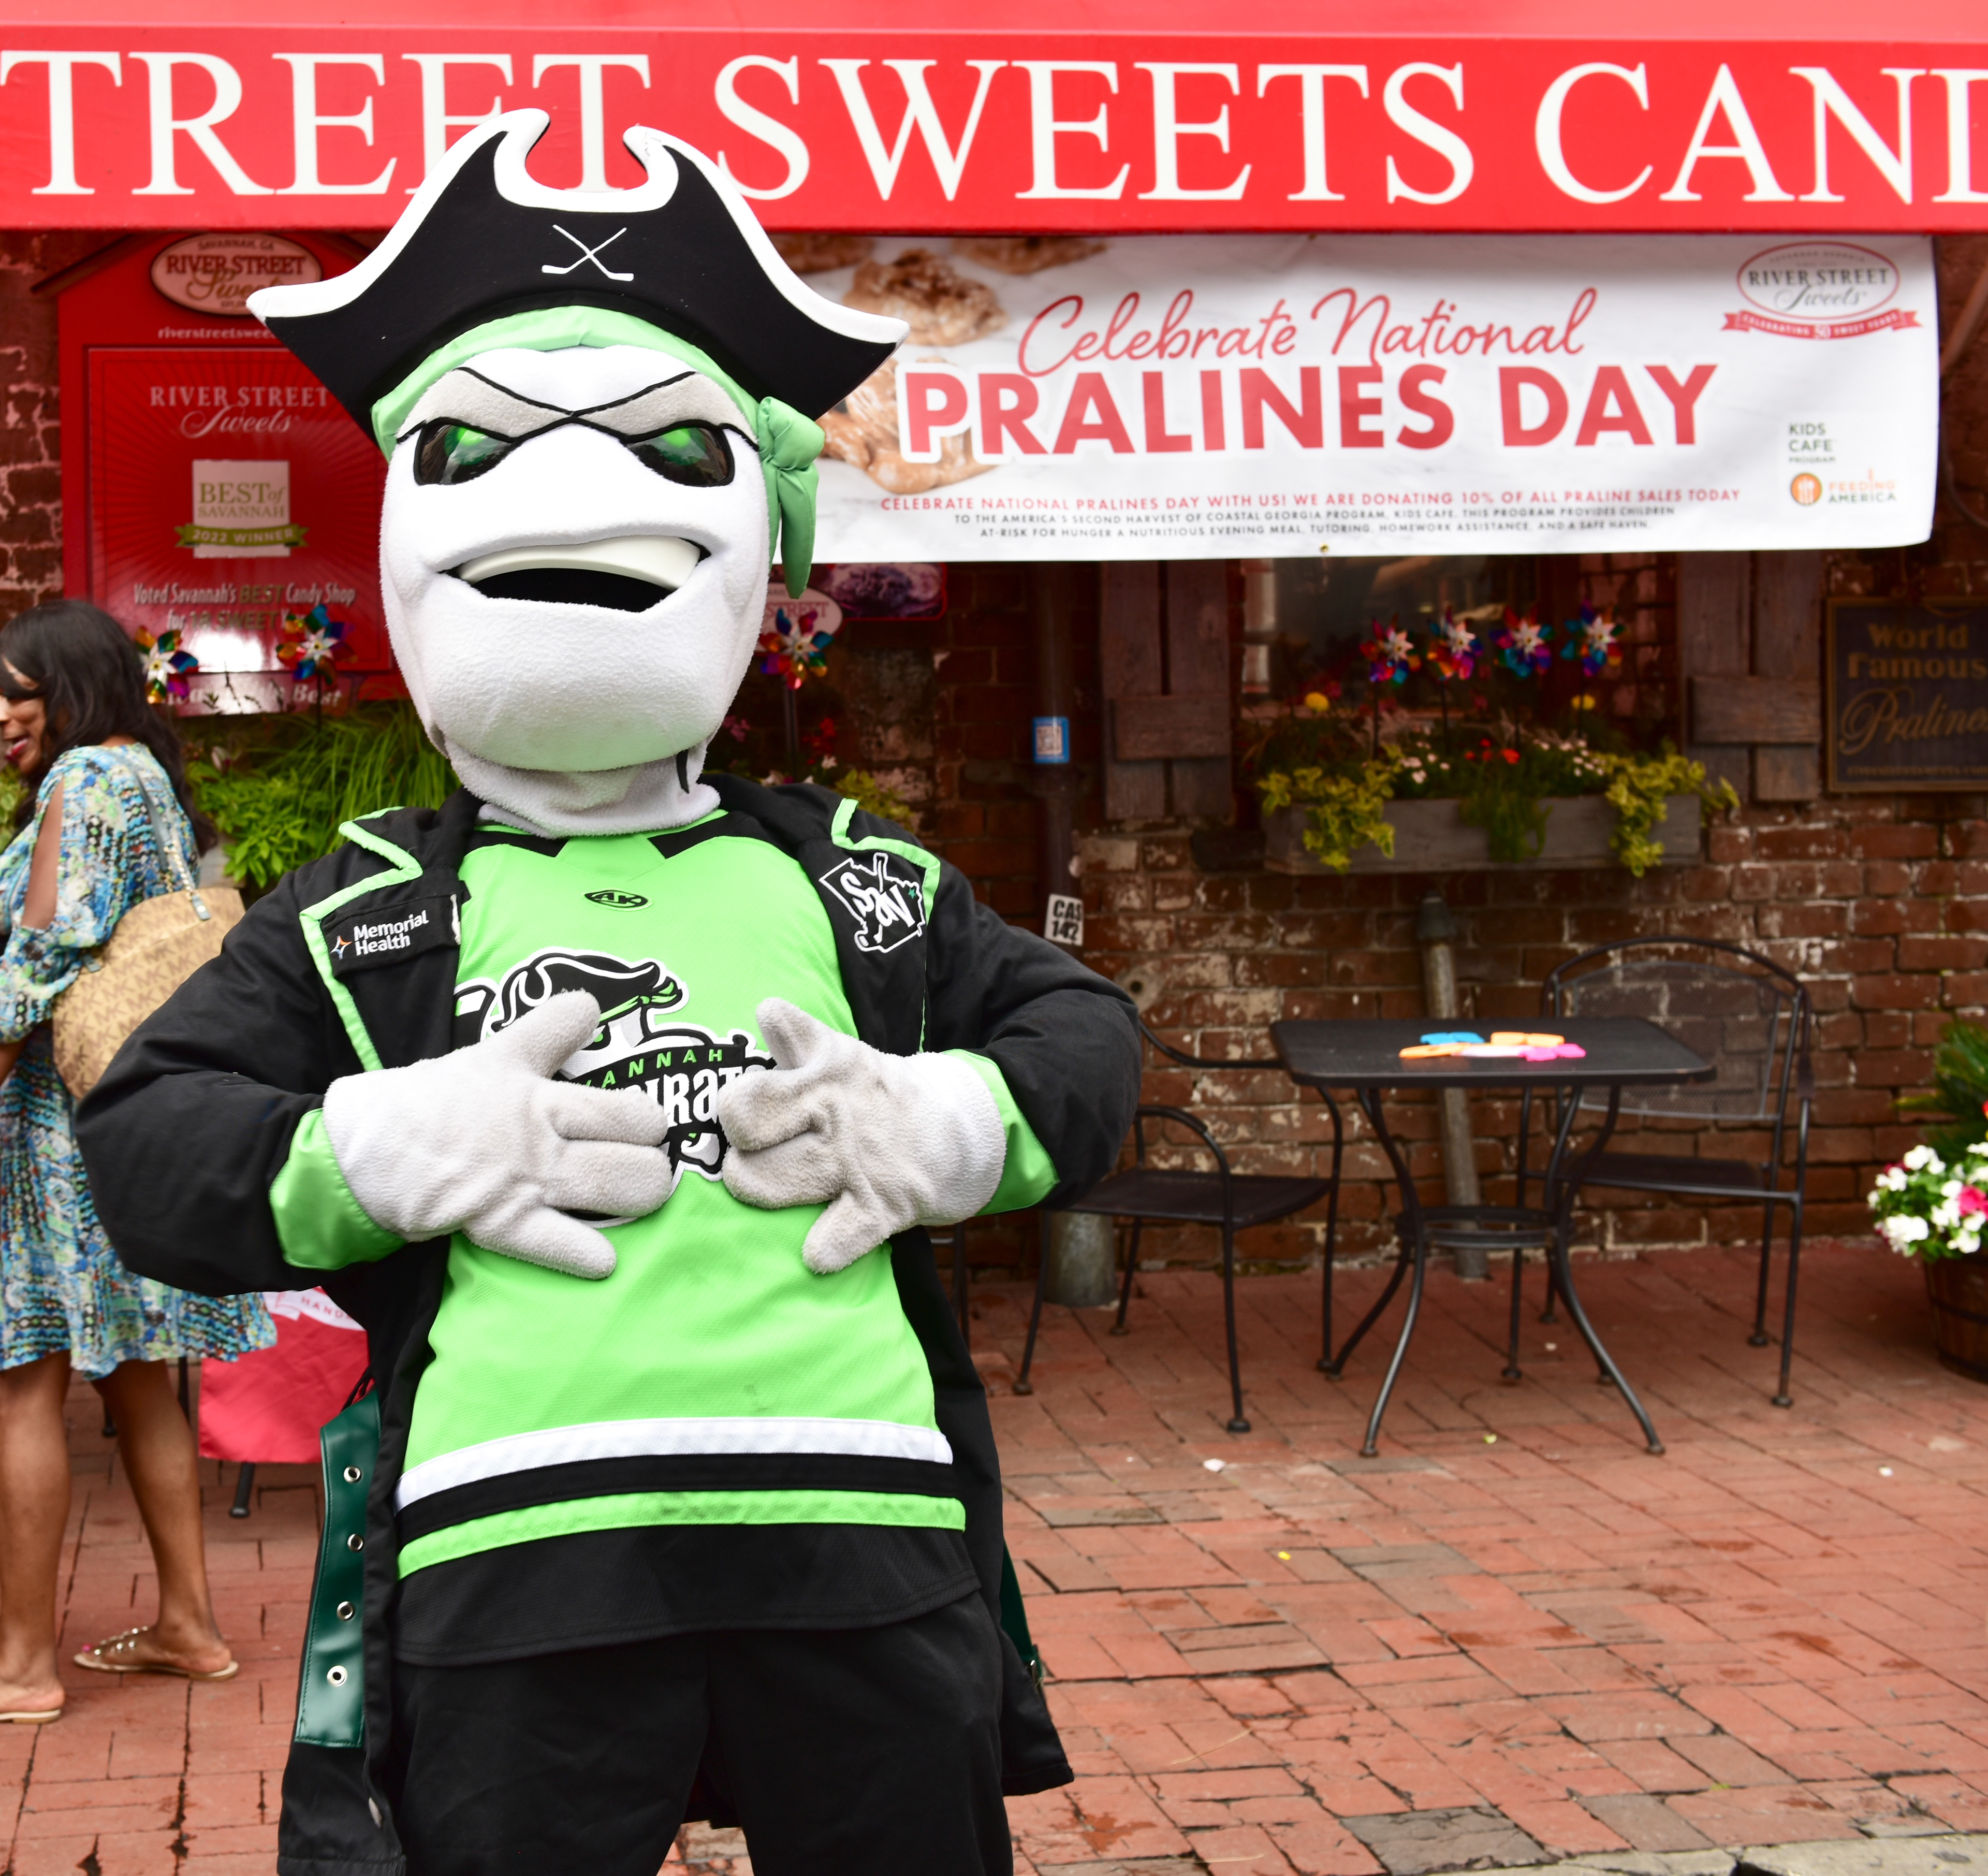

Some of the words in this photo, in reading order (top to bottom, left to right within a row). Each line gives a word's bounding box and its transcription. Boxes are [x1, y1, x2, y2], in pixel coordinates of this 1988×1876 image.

[714, 54, 1474, 204] SWEETS
[167, 255, 227, 274] RIVER
[233, 256, 306, 274] STREET
[1748, 269, 1809, 286] RIVER
[1816, 268, 1889, 284] STREET
[1774, 285, 1861, 311] Sweets
[1018, 288, 1297, 377] Celebrate
[1310, 287, 1598, 369] National
[150, 386, 228, 406] RIVER
[237, 386, 328, 406] STREET
[905, 363, 1455, 455] PRALINES
[1498, 364, 1718, 447] DAY
[181, 404, 293, 439] Sweets
[1790, 423, 1826, 435] KIDS
[1789, 440, 1833, 452] CAFE
[200, 483, 270, 503] BEST
[268, 486, 286, 504] of
[881, 498, 973, 510] CELEBRATE
[982, 498, 1070, 510] NATIONAL
[1077, 498, 1158, 511] PRALINES
[1166, 497, 1200, 509] DAY
[1208, 496, 1252, 507] WITH
[1259, 495, 1287, 507] US!
[1294, 495, 1318, 506] WE
[1326, 493, 1355, 505] ARE
[1362, 493, 1453, 504] DONATING
[1462, 491, 1495, 504] 10%
[1501, 491, 1523, 504] OF
[1530, 491, 1557, 503] ALL
[1565, 490, 1631, 503] PRALINE
[1638, 489, 1683, 502] SALES
[1688, 489, 1740, 501] TODAY
[1829, 492, 1896, 503] AMERICA
[198, 506, 284, 517] SAVANNAH
[955, 515, 970, 523] TO
[976, 515, 997, 523] THE
[1002, 514, 1068, 523] AMERICA'S
[1073, 515, 1121, 523] SECOND
[1127, 514, 1180, 523] HARVEST
[1186, 513, 1202, 522] OF
[1207, 512, 1260, 521] COASTAL
[1265, 511, 1321, 520] GEORGIA
[1394, 510, 1421, 518] KIDS
[1463, 508, 1488, 517] THIS
[1493, 507, 1555, 517] PROGRAM
[1560, 506, 1616, 516] PROVIDES
[1620, 506, 1675, 515] CHILDREN
[193, 529, 228, 543] 2022
[233, 528, 294, 543] WINNER
[980, 529, 1028, 537] AT-RISK
[1033, 529, 1056, 537] FOR
[1062, 529, 1112, 537] HUNGER
[1130, 527, 1205, 536] NUTRITIOUS
[1210, 526, 1265, 535] EVENING
[1380, 523, 1451, 532] HOMEWORK
[1538, 521, 1565, 530] AND
[1568, 521, 1575, 530] A
[1580, 520, 1604, 529] SAFE
[134, 583, 169, 604] Voted
[171, 583, 236, 605] Savannah's
[239, 585, 285, 604] BEST
[286, 583, 323, 606] Candy
[325, 583, 356, 606] Shop
[216, 610, 279, 630] SWEET
[1867, 623, 1968, 649] World
[1848, 652, 1988, 679] Famous
[1839, 685, 1988, 756] Praline
[354, 910, 429, 941] Memorial
[1052, 920, 1078, 941] 142
[355, 933, 411, 956] Health
[302, 1296, 352, 1320] HAND
